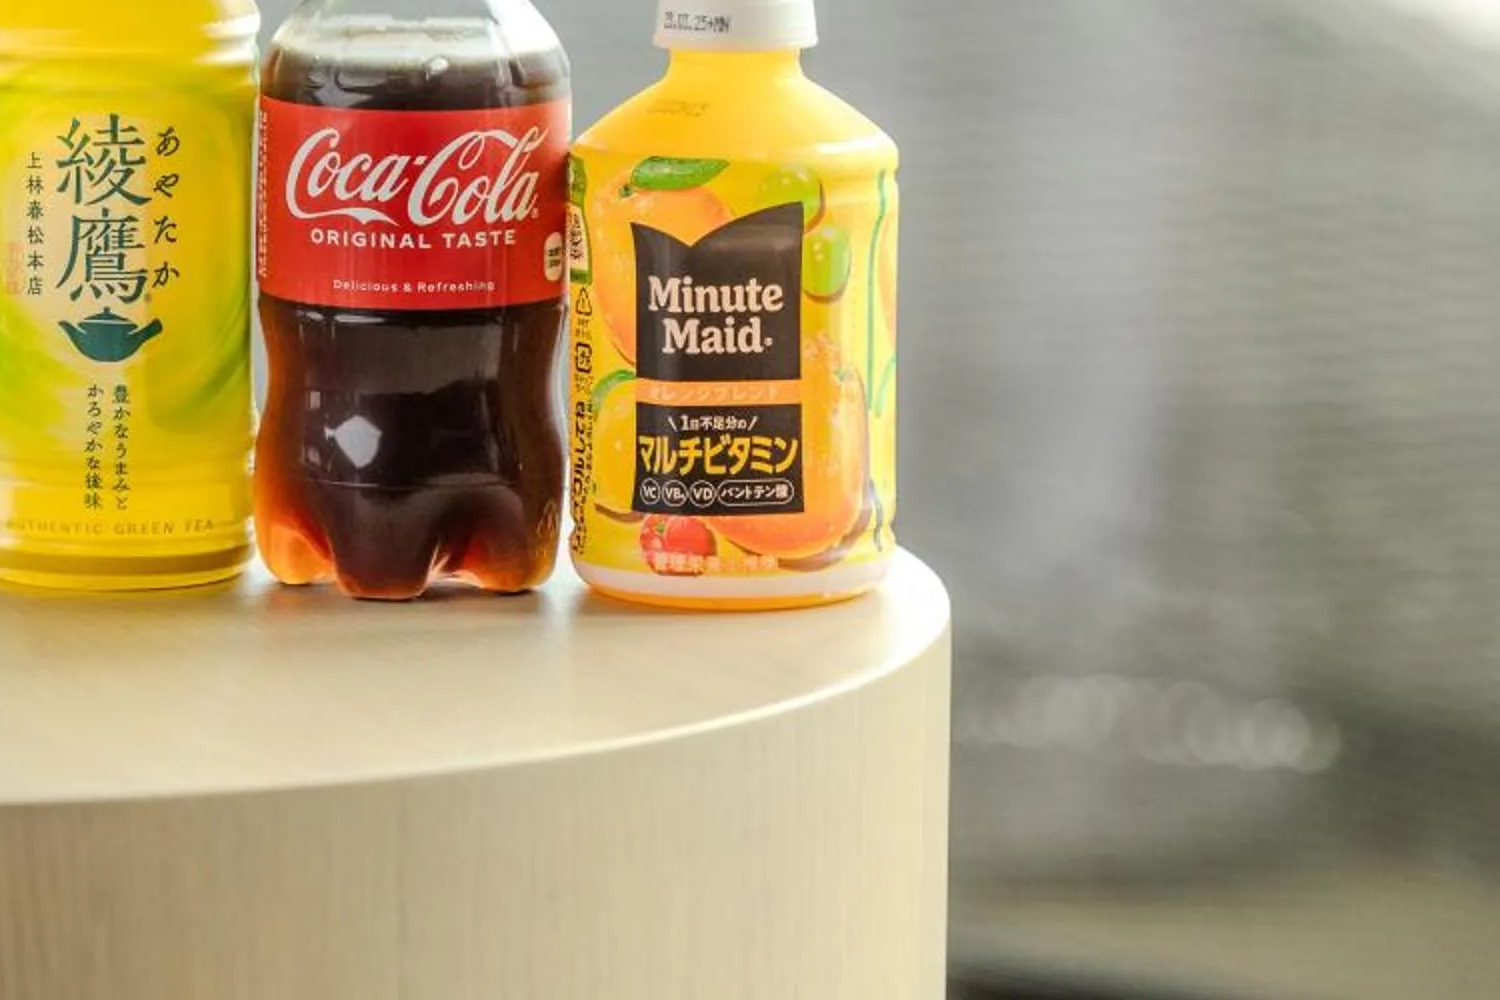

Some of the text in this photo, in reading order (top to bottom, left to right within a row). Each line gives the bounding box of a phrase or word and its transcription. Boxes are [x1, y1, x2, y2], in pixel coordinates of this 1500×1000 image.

[286, 126, 549, 227] Coca-Cola
[26, 152, 44, 296] 上林春松本店
[56, 113, 152, 304] 綾鷹
[152, 126, 180, 288] あやたか
[310, 227, 516, 249] ORIGINAL TASTE
[333, 279, 495, 293] Delicious & Refreshing
[648, 275, 784, 313] Minute
[661, 316, 764, 354] Maid
[638, 433, 798, 476] マルチビタミン
[642, 485, 657, 499] VC
[693, 487, 713, 500] VD
[113, 519, 174, 535] GREEN
[184, 518, 215, 534] TEA
